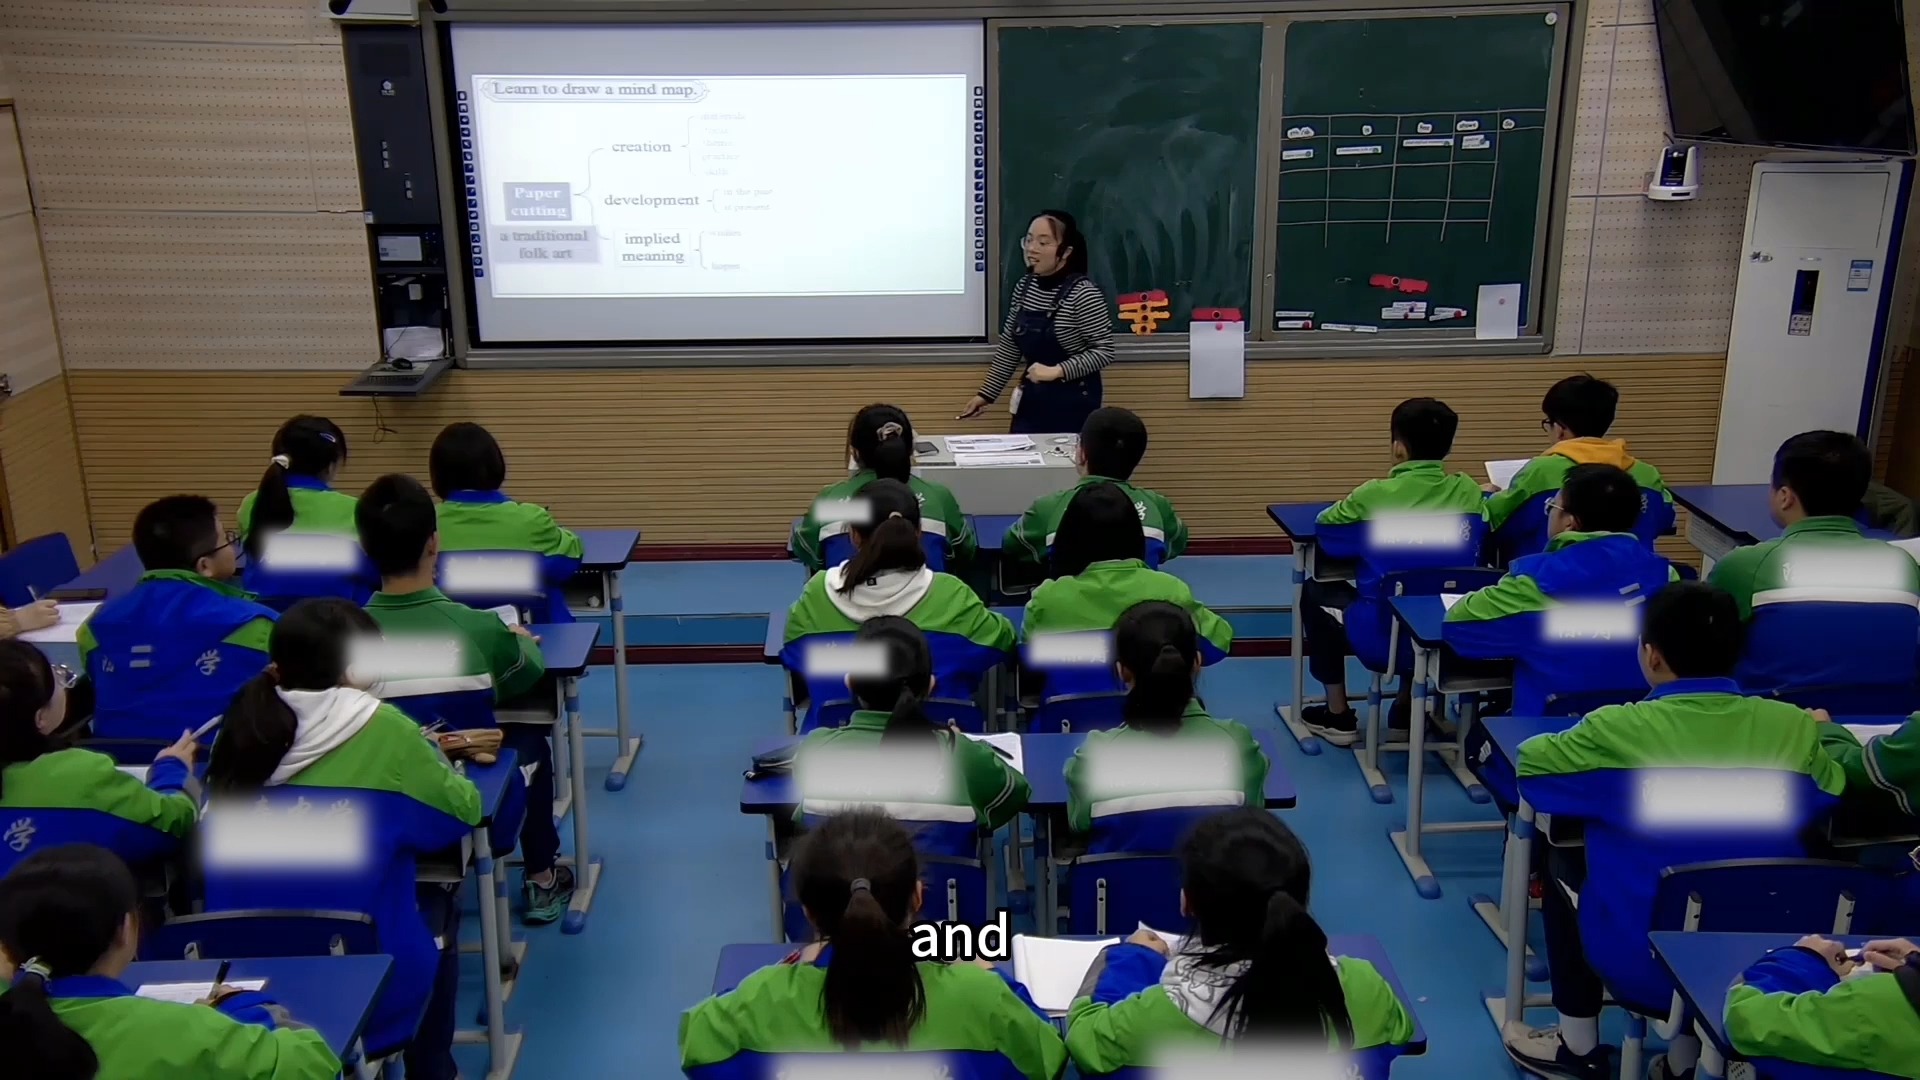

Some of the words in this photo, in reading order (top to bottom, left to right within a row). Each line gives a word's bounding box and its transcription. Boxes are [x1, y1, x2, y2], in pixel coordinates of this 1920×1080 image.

[493, 82, 538, 96] Learn
[543, 84, 558, 96] to
[562, 83, 600, 96] draw
[605, 86, 614, 96] a
[618, 83, 657, 96] mind
[661, 85, 698, 100] map.
[612, 139, 672, 153] creation
[514, 186, 561, 201] Paper
[604, 193, 700, 212] development
[511, 204, 568, 220] cutting
[499, 232, 509, 242] a
[512, 228, 588, 242] traditional
[625, 231, 681, 248] implied
[519, 246, 548, 260] folk
[552, 248, 573, 260] art
[622, 248, 685, 265] meaning
[3, 816, 36, 852] 学
